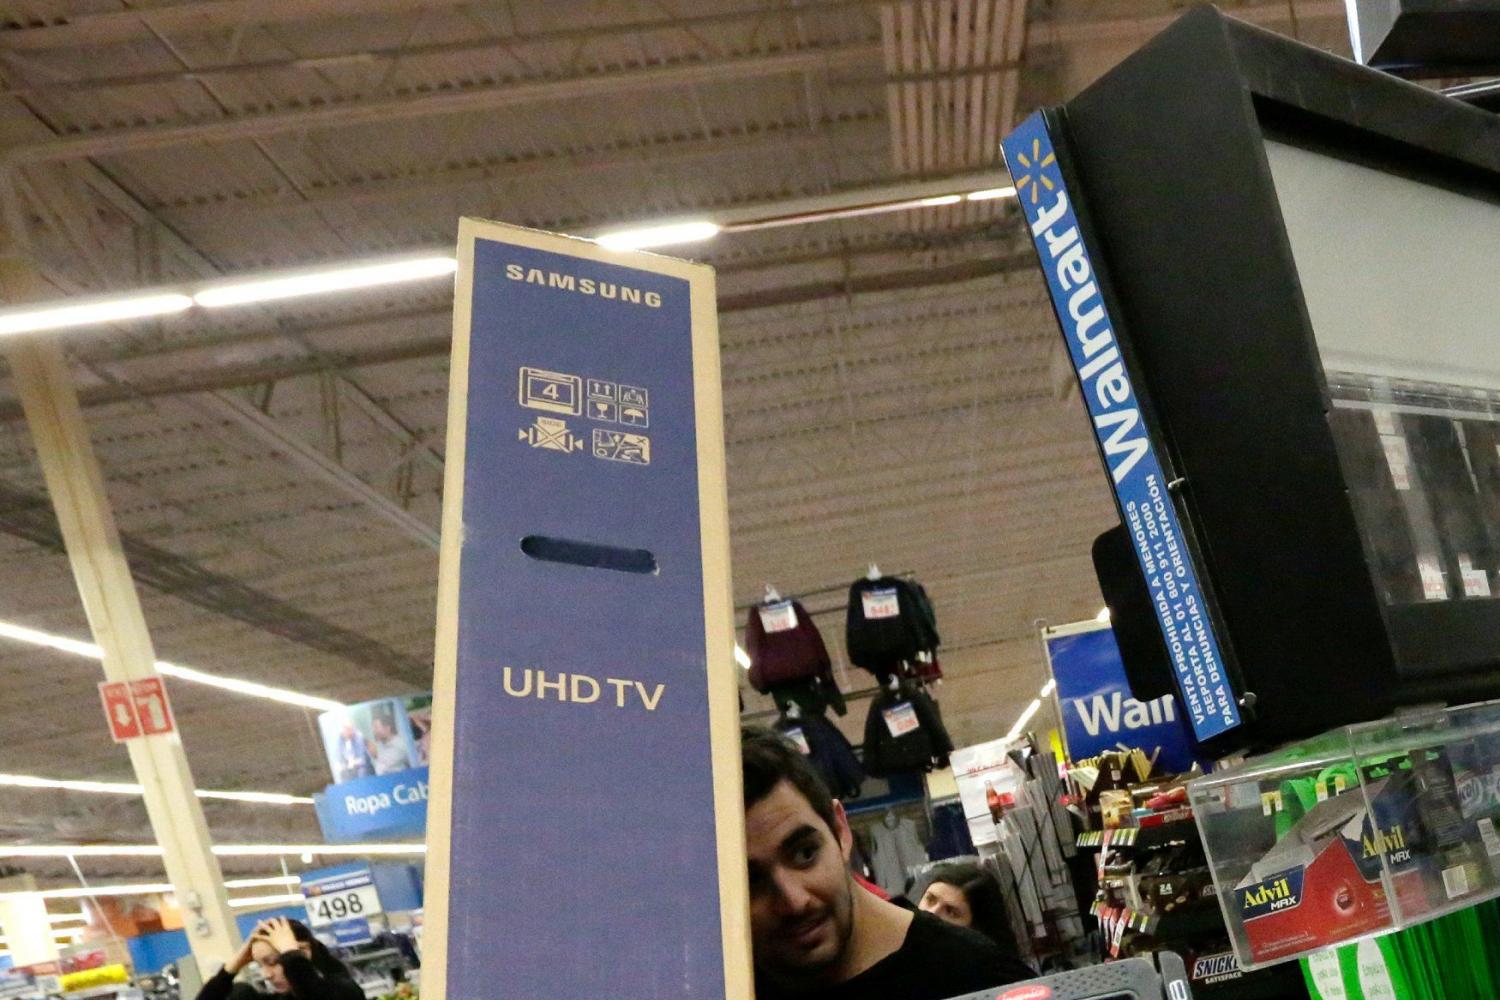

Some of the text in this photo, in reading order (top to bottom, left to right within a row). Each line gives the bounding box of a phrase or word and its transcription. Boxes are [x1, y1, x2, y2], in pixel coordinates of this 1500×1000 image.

[505, 263, 662, 309] SAMSUNG
[1033, 190, 1150, 485] Walmart
[542, 383, 560, 401] 4
[1126, 501, 1205, 725] VENTA PROHIBIDA A MENORES
[1141, 503, 1217, 715] REPORTA AL 01 800 911 2000
[1146, 474, 1235, 726] PARA DENUNCIAS Y ORIENTACIÓN
[503, 666, 665, 711] UHD TV
[345, 791, 391, 815] Ropa
[1244, 878, 1290, 909] Advil
[1270, 895, 1297, 911] MAX
